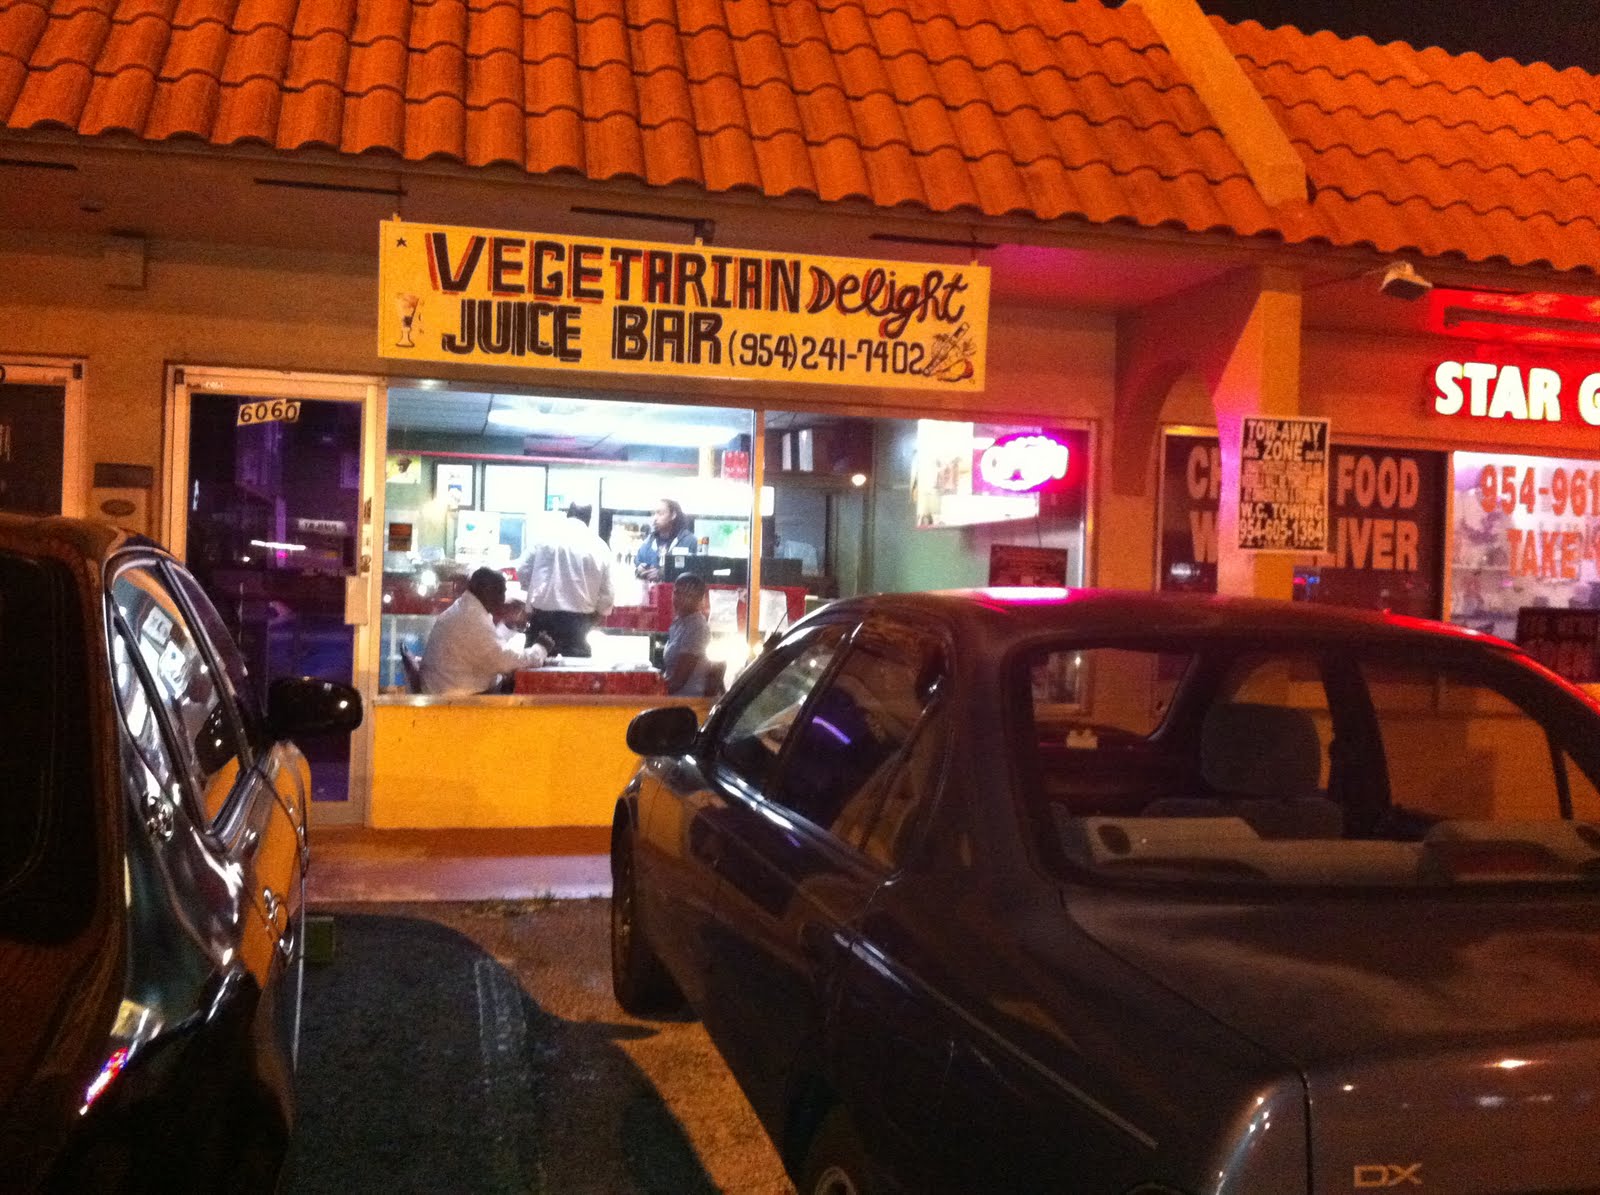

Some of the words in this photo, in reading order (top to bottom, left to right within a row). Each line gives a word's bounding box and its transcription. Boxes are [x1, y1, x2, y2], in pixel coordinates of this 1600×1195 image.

[424, 231, 801, 314] VEGETARIAN
[804, 264, 968, 339] Delight
[441, 298, 583, 362] JUICE
[611, 304, 723, 366] BAR
[1434, 360, 1562, 422] STAR
[240, 401, 298, 422] 6060
[1247, 420, 1321, 441] TOW-AWAY
[1262, 440, 1303, 460] ZONE
[1336, 455, 1420, 509] FOOD
[1272, 502, 1325, 521] TOWING
[1507, 528, 1581, 579] TAKE
[1353, 1163, 1423, 1187] DX
